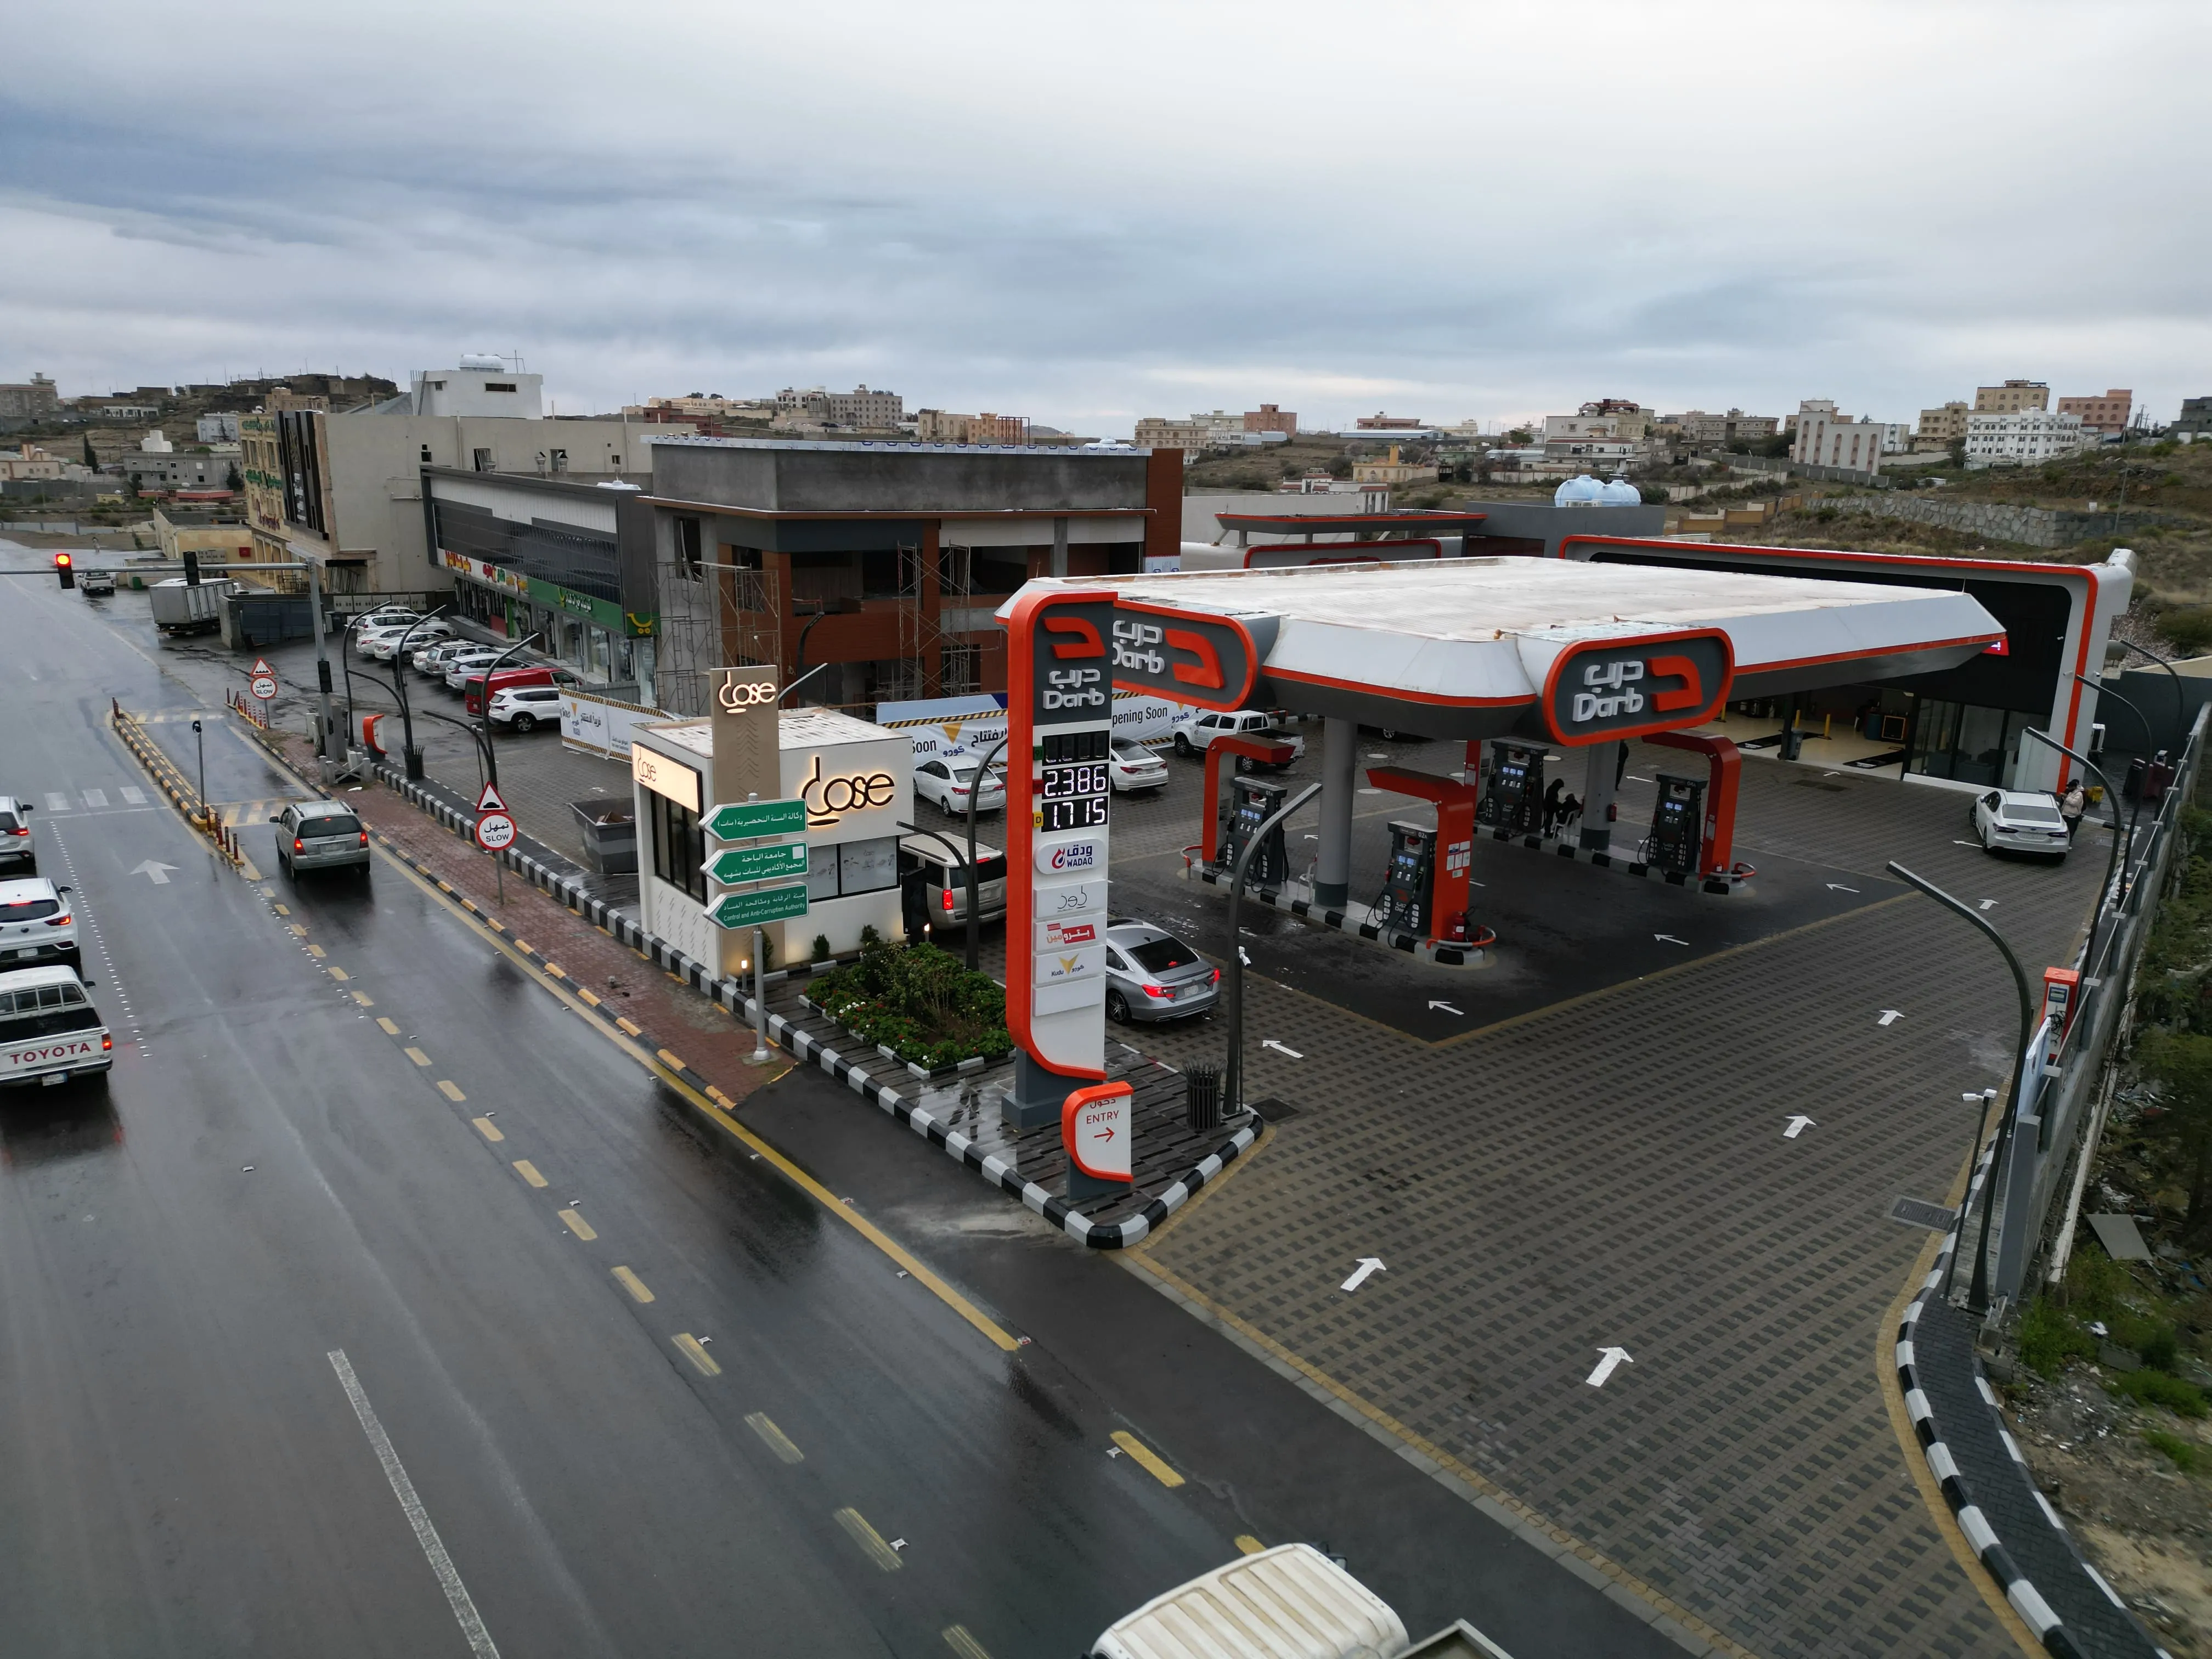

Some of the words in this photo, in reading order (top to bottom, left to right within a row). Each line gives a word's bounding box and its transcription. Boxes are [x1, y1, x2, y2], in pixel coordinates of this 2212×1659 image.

[1113, 620, 1163, 647] درب
[1049, 669, 1100, 689] درب
[1584, 661, 1644, 693] درب
[719, 671, 776, 708] dose
[1043, 688, 1105, 709] Darb
[1572, 687, 1644, 722] Darb
[1112, 708, 1143, 728] pening
[1146, 707, 1167, 720] Soon
[1171, 712, 1189, 724] كودو
[943, 745, 965, 757] كودو
[802, 757, 895, 816] dose
[1045, 765, 1106, 797] 2.386
[771, 813, 787, 822] السنة
[788, 811, 803, 821] وكالة
[1053, 798, 1105, 828] 1.715
[484, 821, 509, 833] تمهل
[486, 834, 509, 842] SLOW
[764, 851, 786, 860] جامعة
[1067, 844, 1093, 857] ودق
[742, 853, 763, 863] الباحة
[1067, 857, 1093, 867] WADAQ
[785, 860, 805, 871] المجمع
[751, 907, 784, 916] Anti-Corruption
[785, 902, 805, 911] Authority
[1046, 929, 1090, 944] بترومين
[1071, 964, 1084, 973] كودو
[10, 1042, 91, 1064] TOYOTA
[1086, 1110, 1119, 1125] ENTRY
